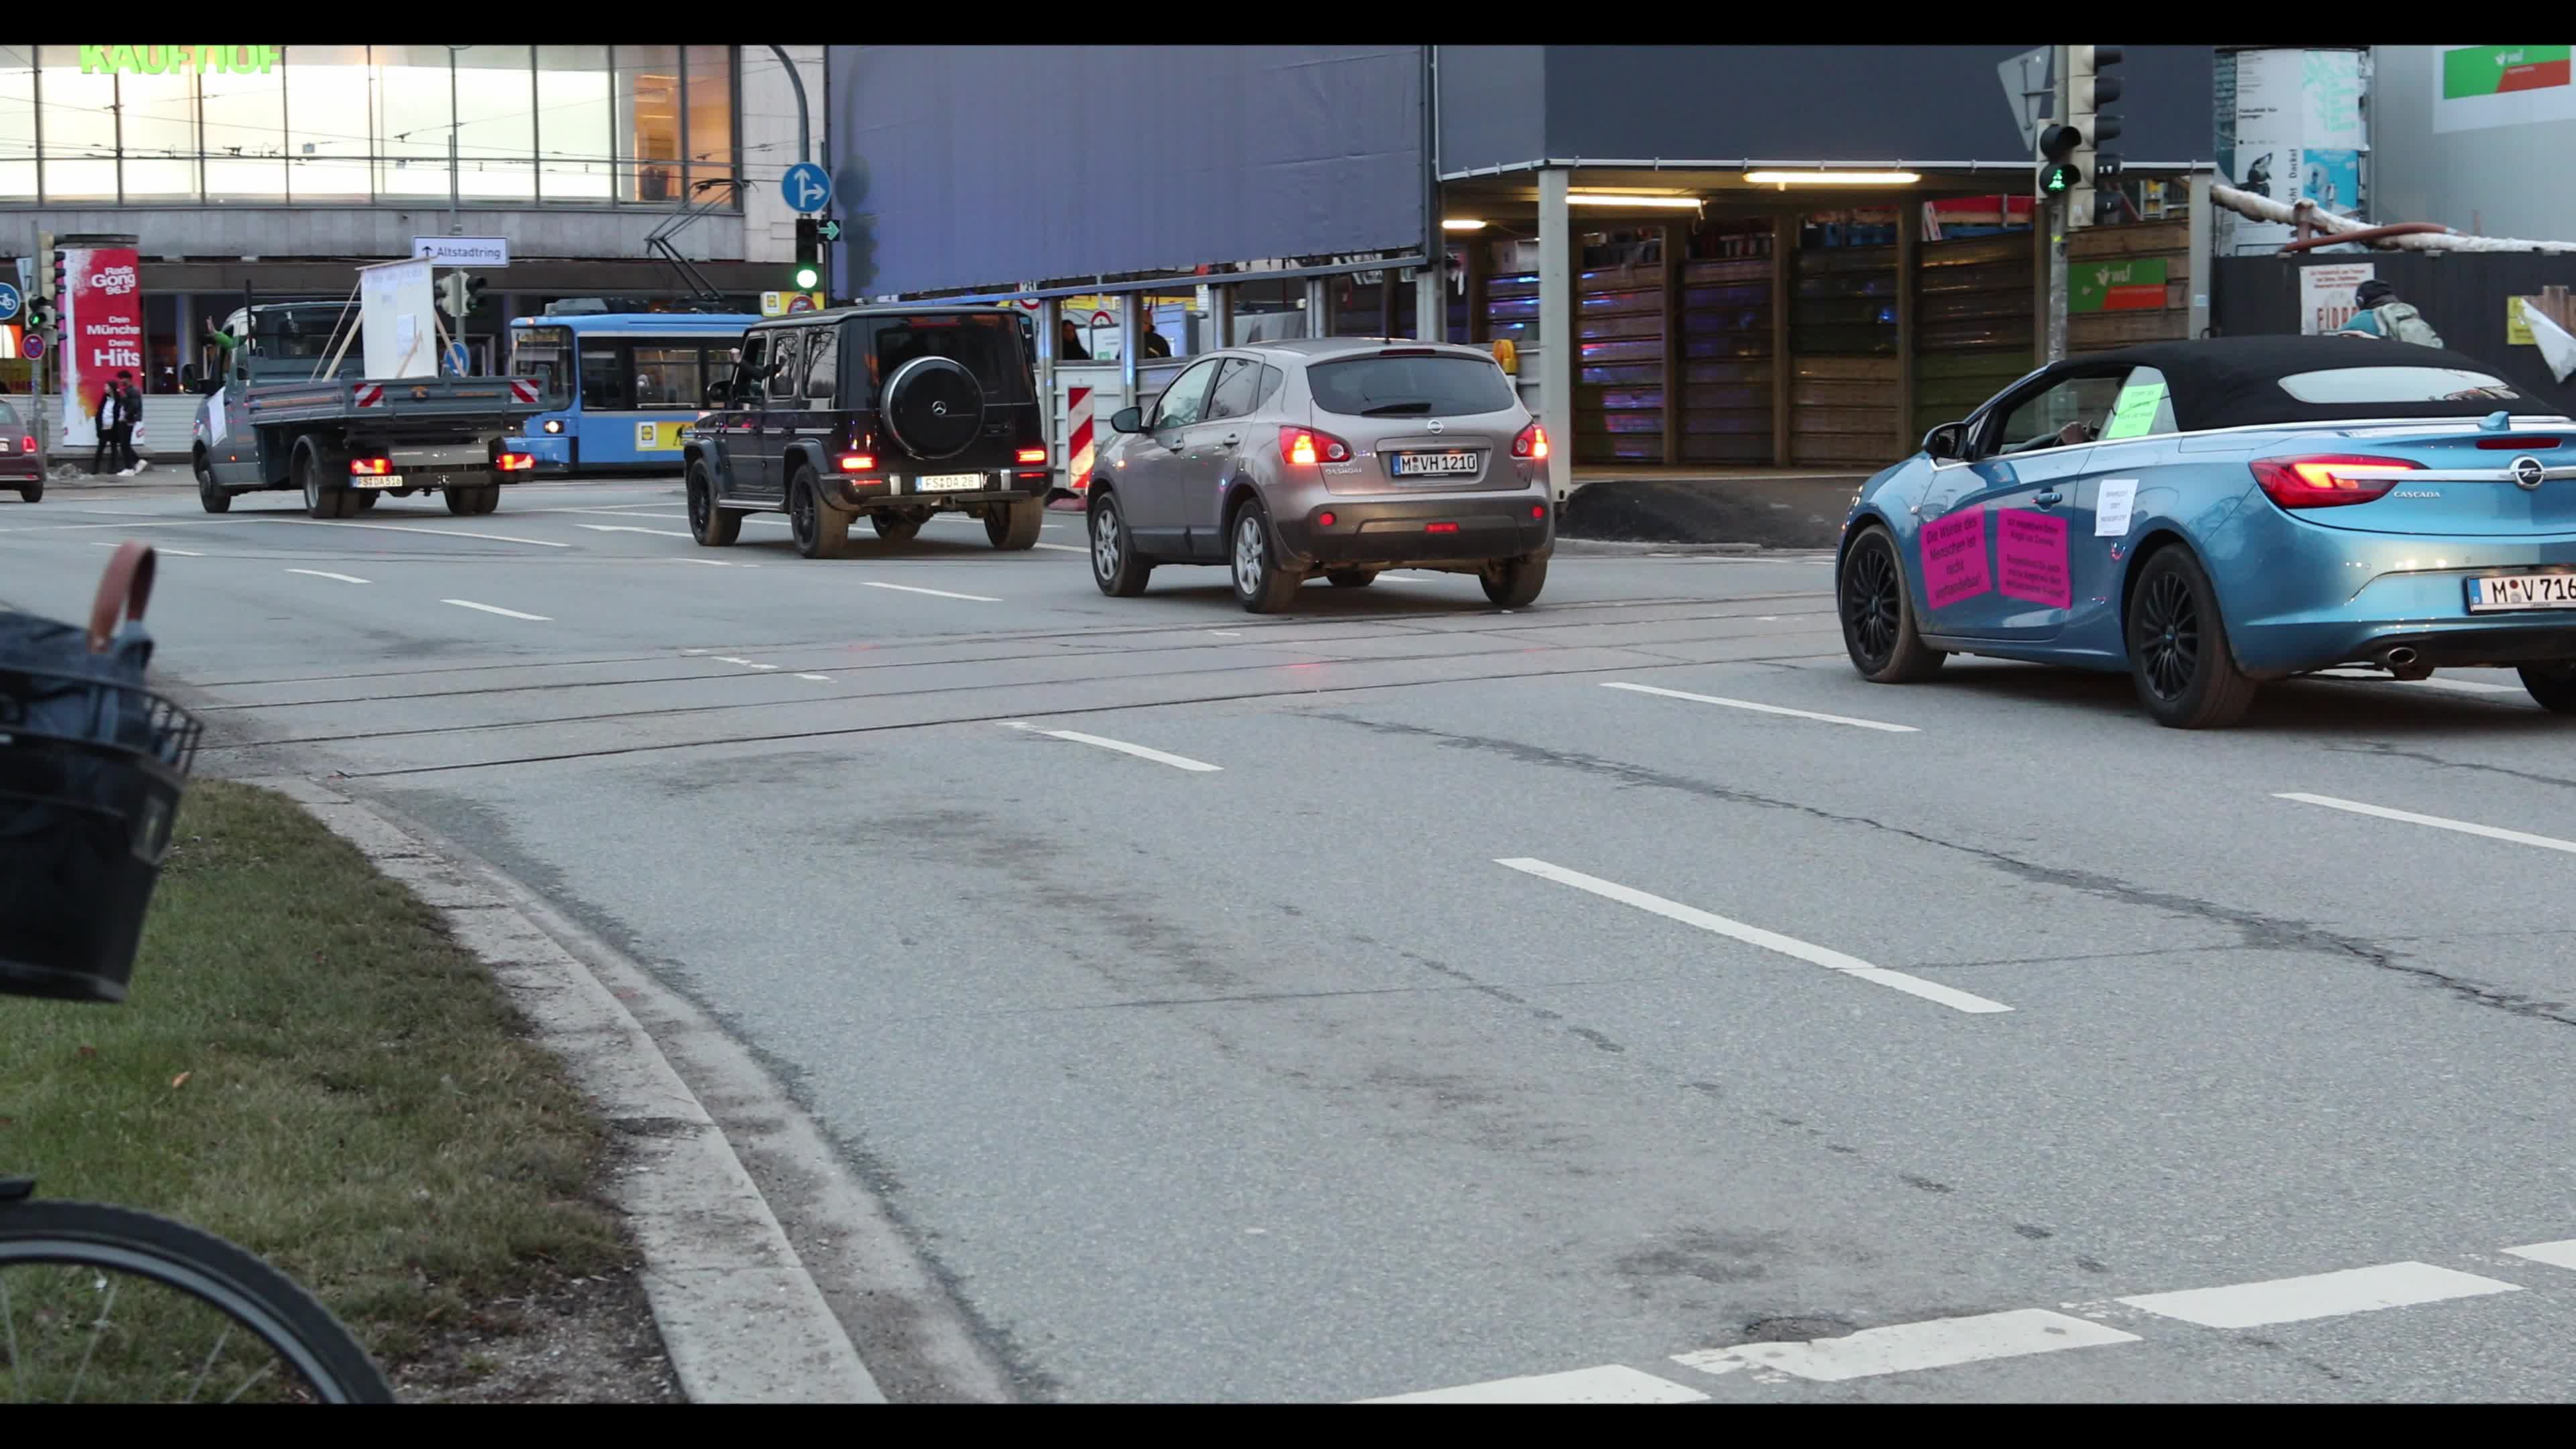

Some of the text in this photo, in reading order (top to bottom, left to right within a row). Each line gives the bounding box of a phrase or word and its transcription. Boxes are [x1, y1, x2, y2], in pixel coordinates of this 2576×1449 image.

[80, 46, 279, 74] KAUFHOF
[437, 247, 500, 260] Altstadtring
[105, 266, 133, 276] Radio
[91, 273, 136, 287] Gong
[108, 339, 135, 347] Deine
[94, 348, 140, 366] Hits
[1402, 455, 1475, 472] M VH 1210
[926, 476, 974, 488] FS DA 28
[2394, 490, 2440, 498] CASCADA
[2491, 581, 2508, 604] M
[2522, 579, 2534, 600] V
